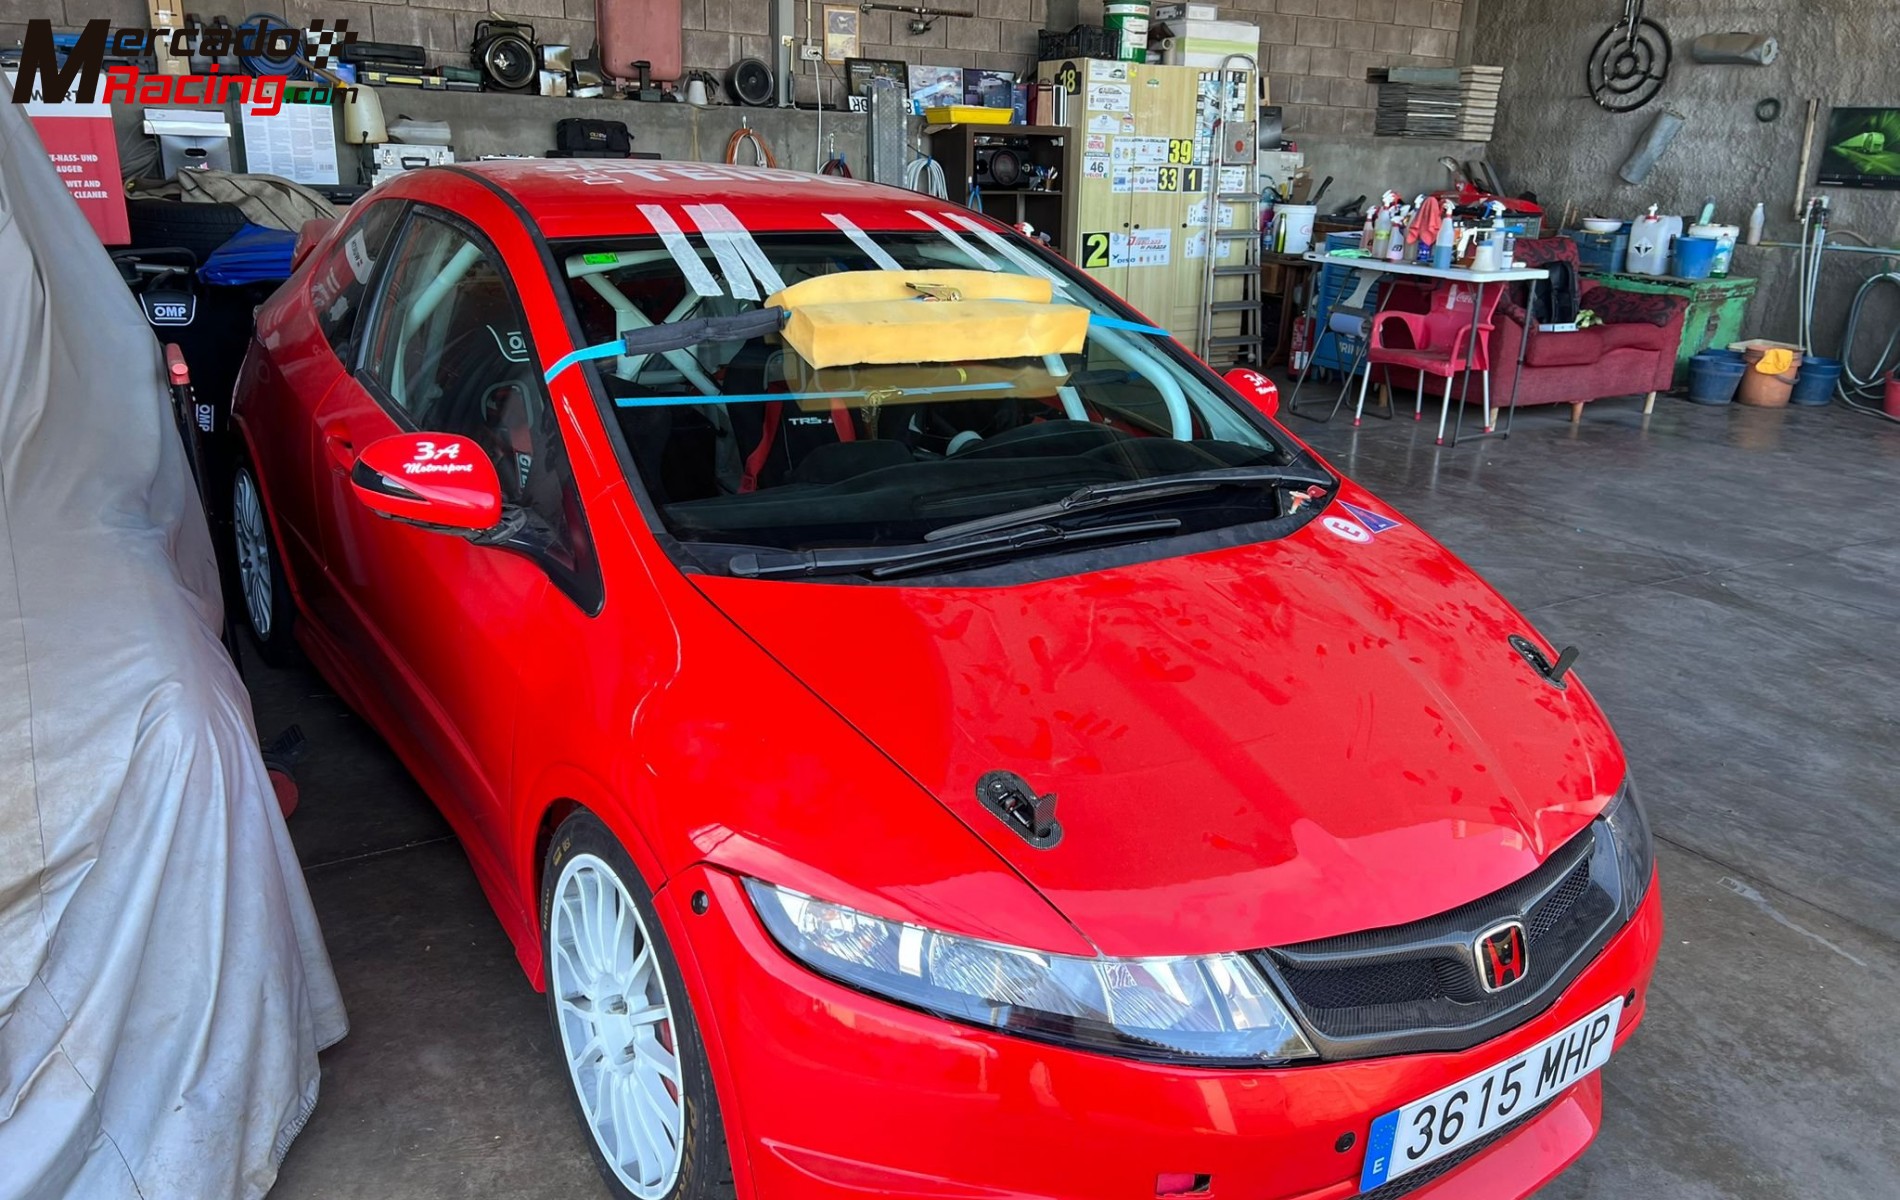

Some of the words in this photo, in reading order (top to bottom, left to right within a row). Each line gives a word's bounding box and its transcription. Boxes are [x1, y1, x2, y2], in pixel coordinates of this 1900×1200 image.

[1060, 68, 1076, 93] 18
[1103, 103, 1113, 111] 42
[81, 154, 98, 162] UND
[1169, 140, 1192, 163] 39
[1090, 161, 1104, 173] 46
[84, 180, 101, 188] AND
[1158, 167, 1178, 190] 33
[1188, 169, 1196, 190] 1
[74, 191, 108, 199] CLEANER
[1086, 233, 1108, 267] 2
[154, 306, 187, 317] OMP
[199, 404, 211, 432] OMP
[413, 441, 460, 460] 3A
[402, 462, 473, 475] Motorsport
[1406, 1059, 1527, 1161] 3615
[1534, 1013, 1611, 1099] MHP
[1372, 1156, 1385, 1176] E
